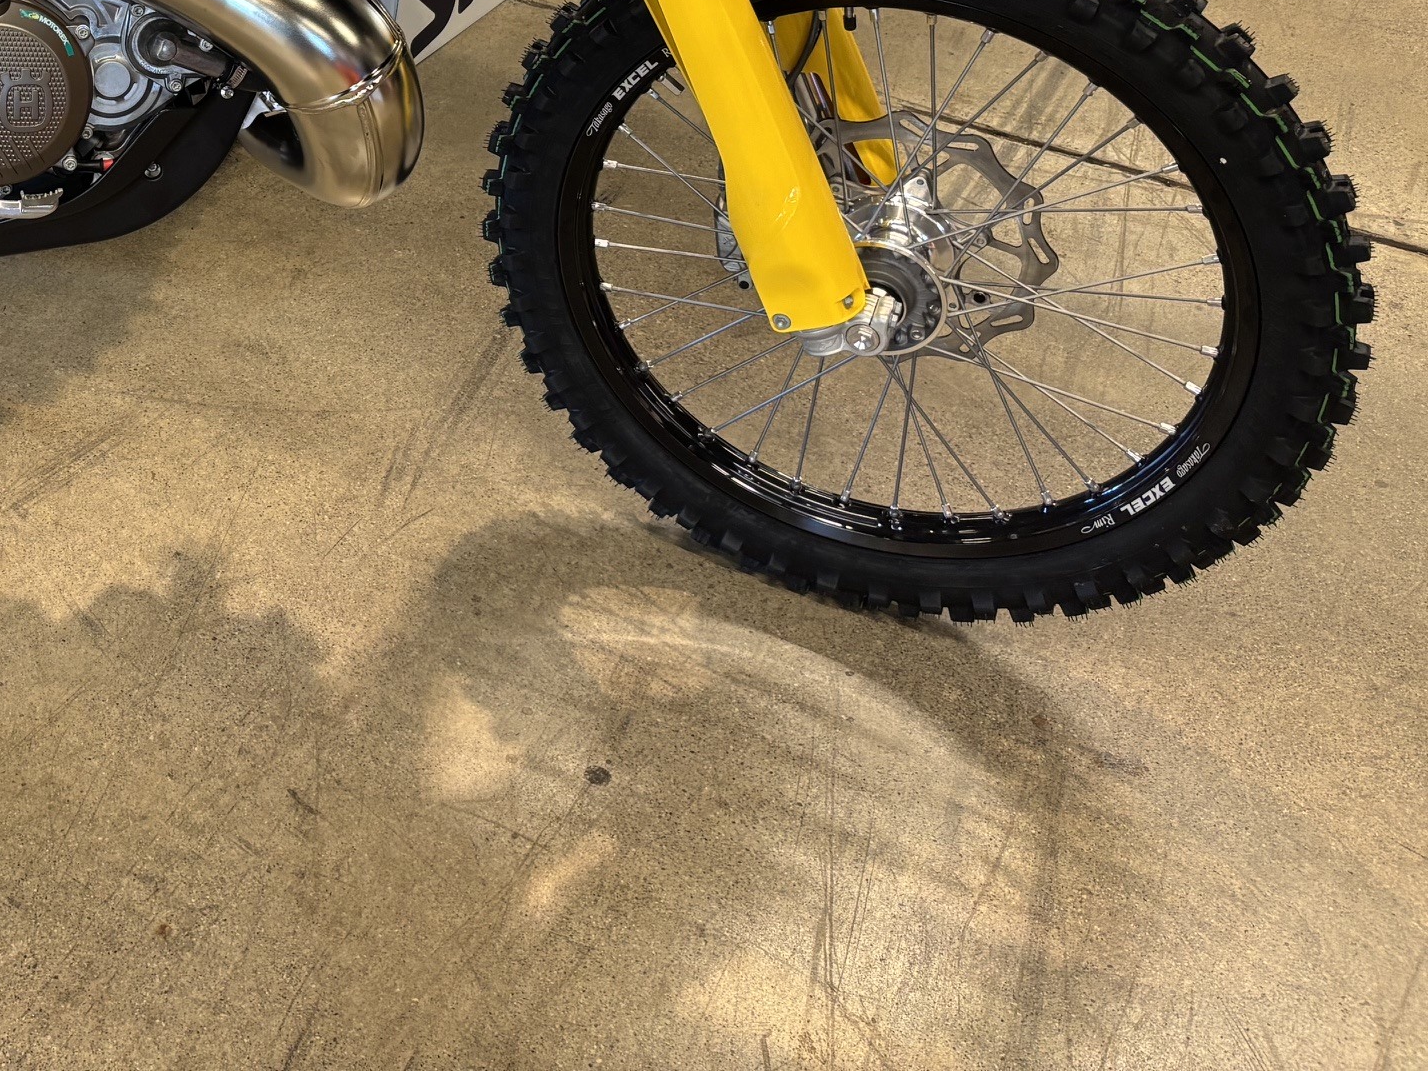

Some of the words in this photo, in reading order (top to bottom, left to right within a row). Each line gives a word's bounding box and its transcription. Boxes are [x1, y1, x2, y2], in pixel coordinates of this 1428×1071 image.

[38, 14, 70, 46] MOTOREX
[586, 101, 613, 137] Takasago
[612, 60, 659, 101] EXCEL
[1176, 442, 1211, 478] Takasago
[1120, 476, 1176, 516] EXCEL
[1080, 513, 1116, 534] Rim
